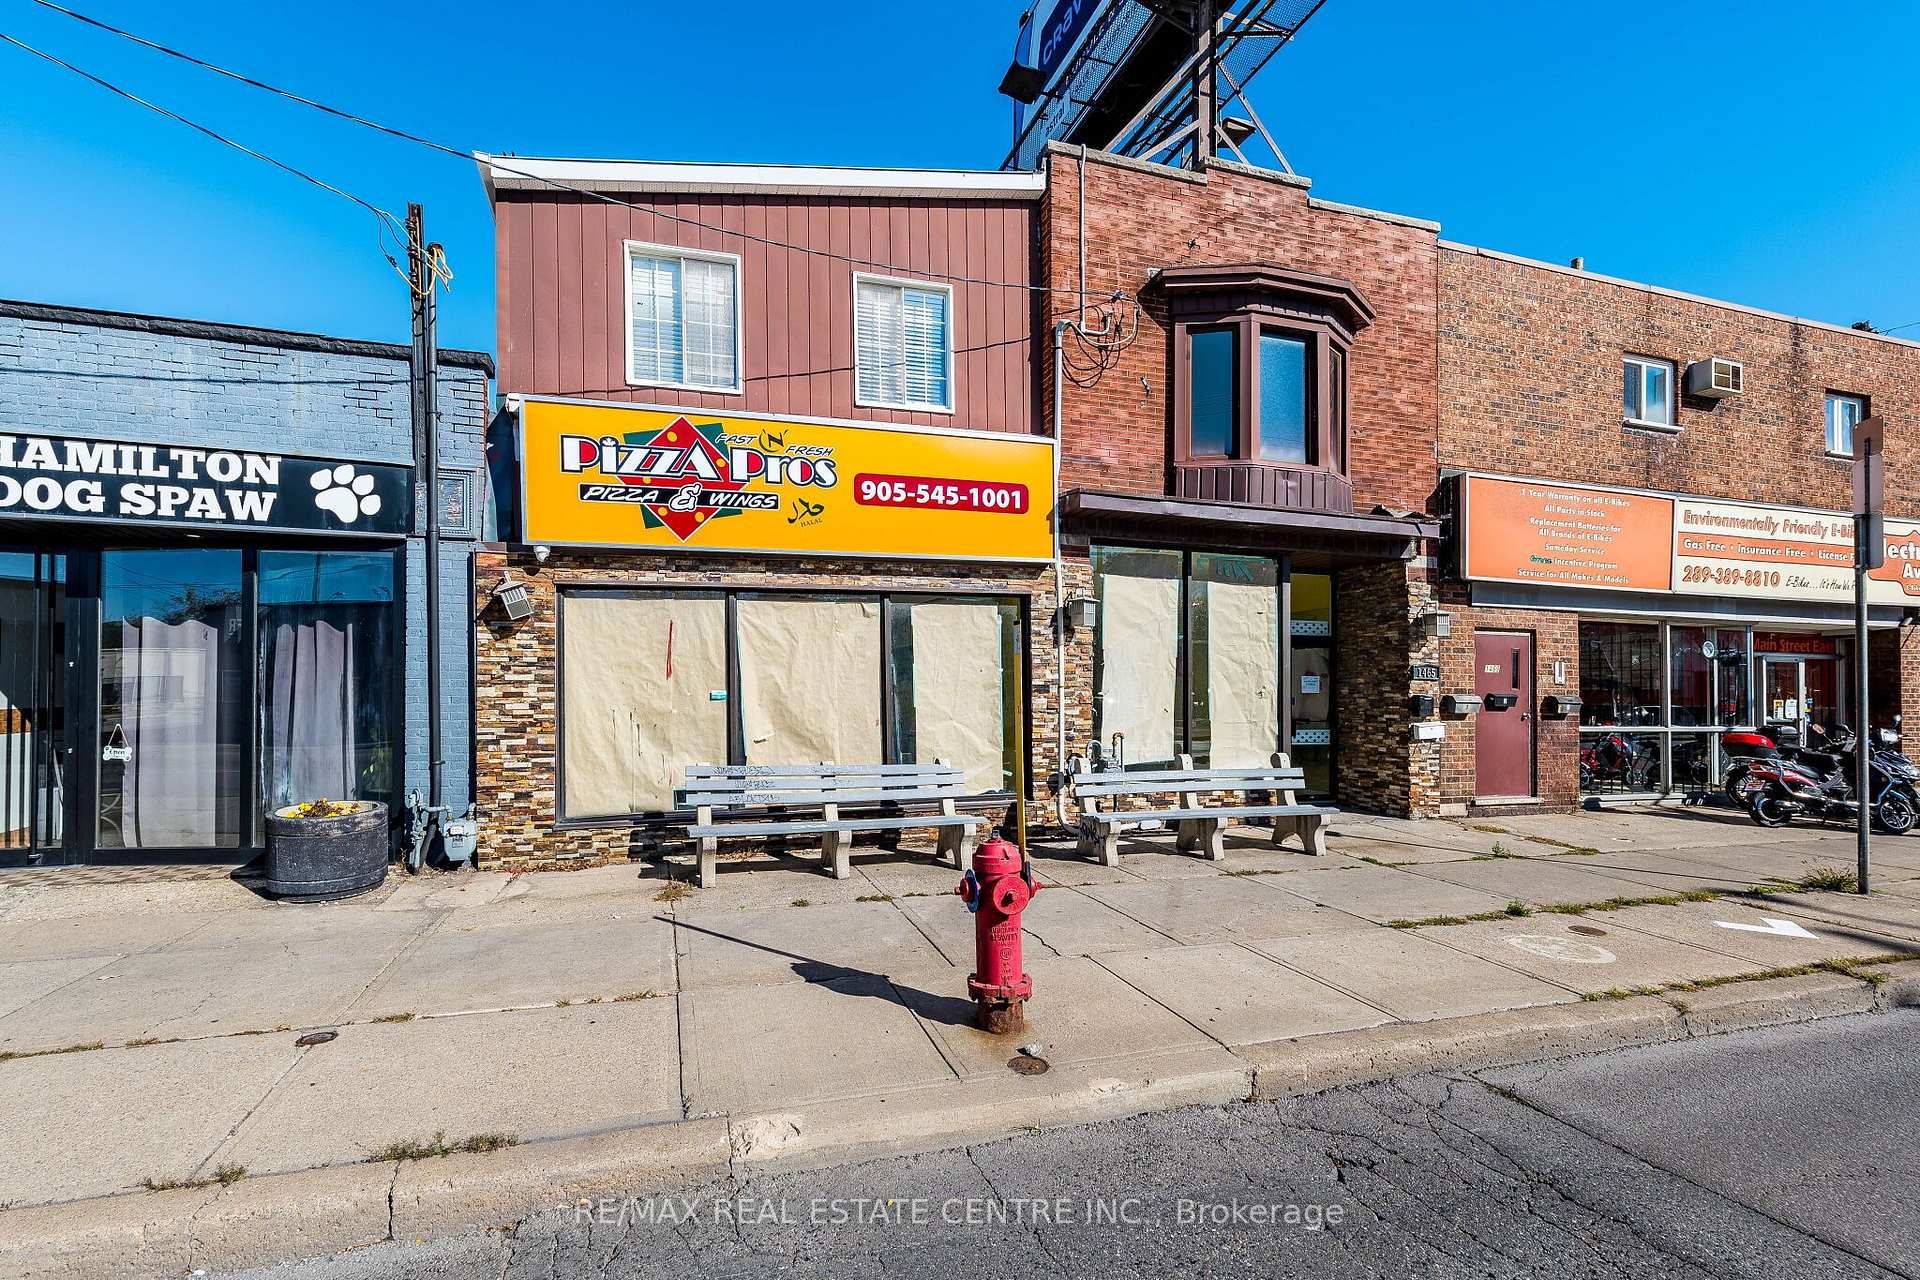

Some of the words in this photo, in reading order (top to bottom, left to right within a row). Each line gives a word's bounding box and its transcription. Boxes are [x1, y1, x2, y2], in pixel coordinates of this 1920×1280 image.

[715, 432, 757, 445] FAST
[785, 445, 833, 456] FRESH
[730, 446, 838, 488] Pros
[120, 483, 277, 522] SPAW
[584, 486, 659, 502] PIZZA
[670, 484, 701, 511] &
[709, 492, 776, 508] WINGS
[861, 480, 1021, 509] 905-545-1001
[1530, 489, 1545, 498] Year
[1547, 490, 1581, 503] Warranty
[1544, 504, 1555, 512] All
[1557, 506, 1576, 515] Parts
[1586, 509, 1605, 517] Stock
[800, 518, 823, 527] HALAL
[1530, 516, 1575, 529] Replacement
[1577, 521, 1609, 532] Batteries
[1611, 524, 1621, 533] for
[1683, 510, 1779, 535] Environmentally
[1783, 519, 1828, 539] Friendly
[1539, 528, 1549, 537] All
[1551, 530, 1576, 540] Brands
[1545, 543, 1577, 554] Sameday
[1579, 546, 1605, 555] Service
[1683, 539, 1703, 550] Gas
[1706, 541, 1726, 552] Free
[1738, 544, 1781, 557] Insurance
[1786, 547, 1806, 558] Free
[1819, 551, 1848, 562] License
[1883, 537, 1920, 560] lect
[1554, 557, 1587, 567] Incentive
[1588, 560, 1618, 570] Program
[1518, 568, 1545, 578] Service
[1546, 570, 1557, 578] for
[1559, 571, 1569, 579] All
[1571, 572, 1594, 581] Makes
[1604, 575, 1631, 584] Models
[1682, 565, 1781, 588] 289-389-8810
[1780, 639, 1810, 653] Street
[1813, 640, 1835, 653] Ea
[1417, 667, 1436, 678] 1465
